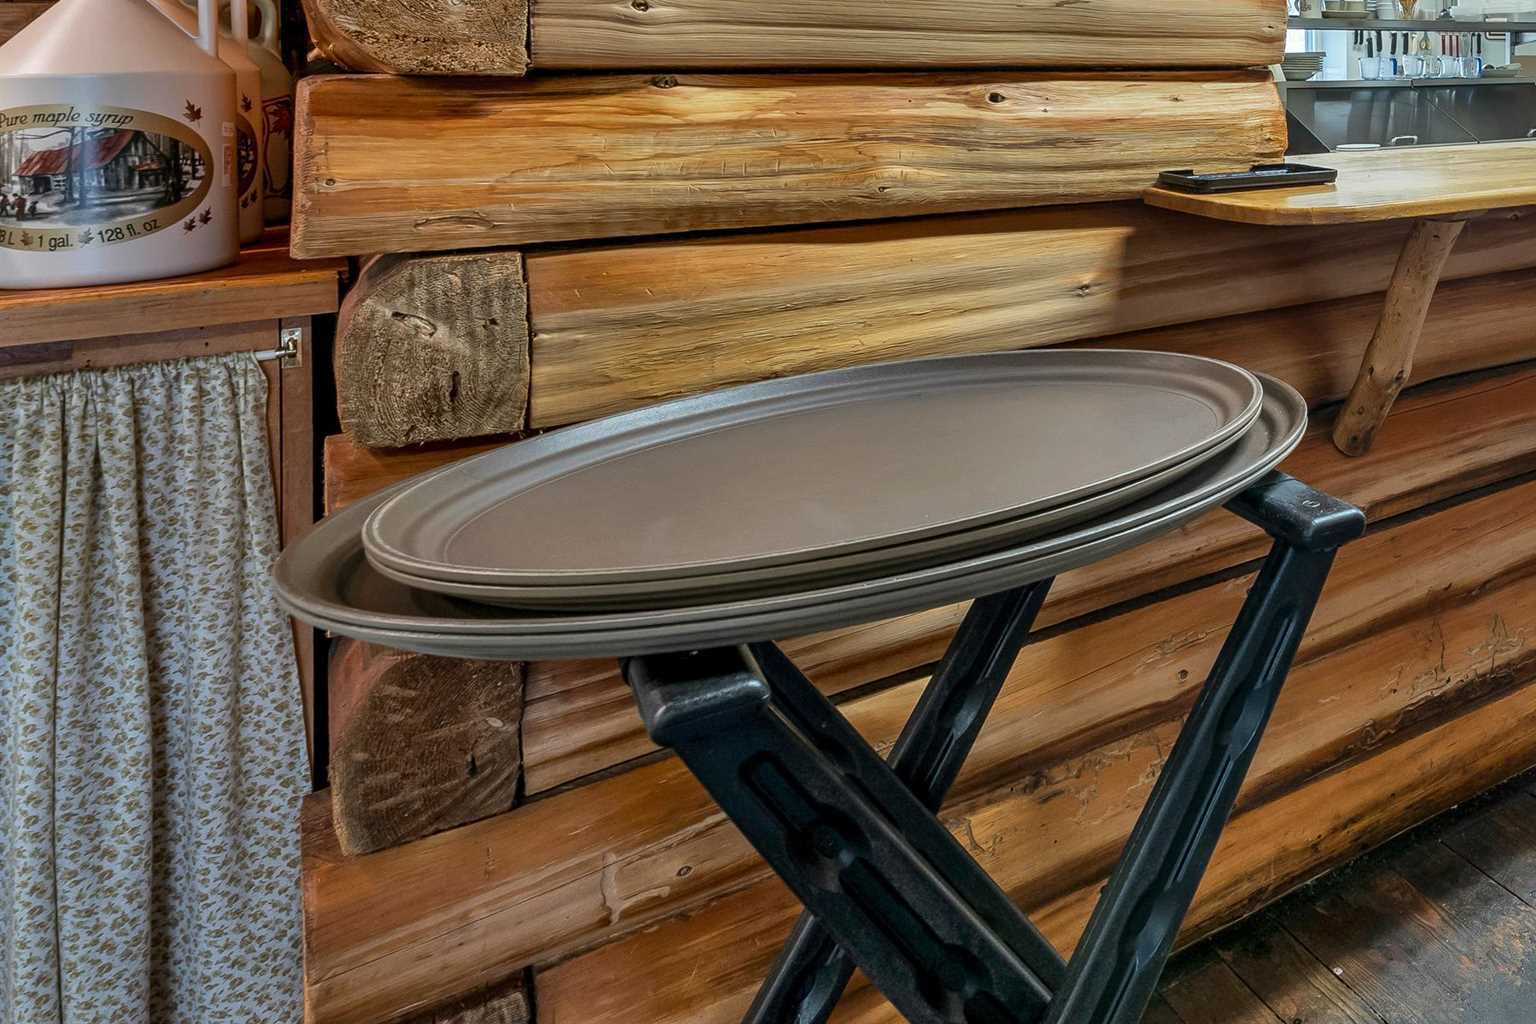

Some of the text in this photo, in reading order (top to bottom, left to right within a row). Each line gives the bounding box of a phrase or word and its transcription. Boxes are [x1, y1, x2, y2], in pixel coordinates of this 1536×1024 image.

[32, 106, 81, 127] maple
[86, 112, 135, 128] syrup
[48, 233, 74, 252] gal.
[98, 227, 125, 243] 128
[143, 219, 162, 232] oz
